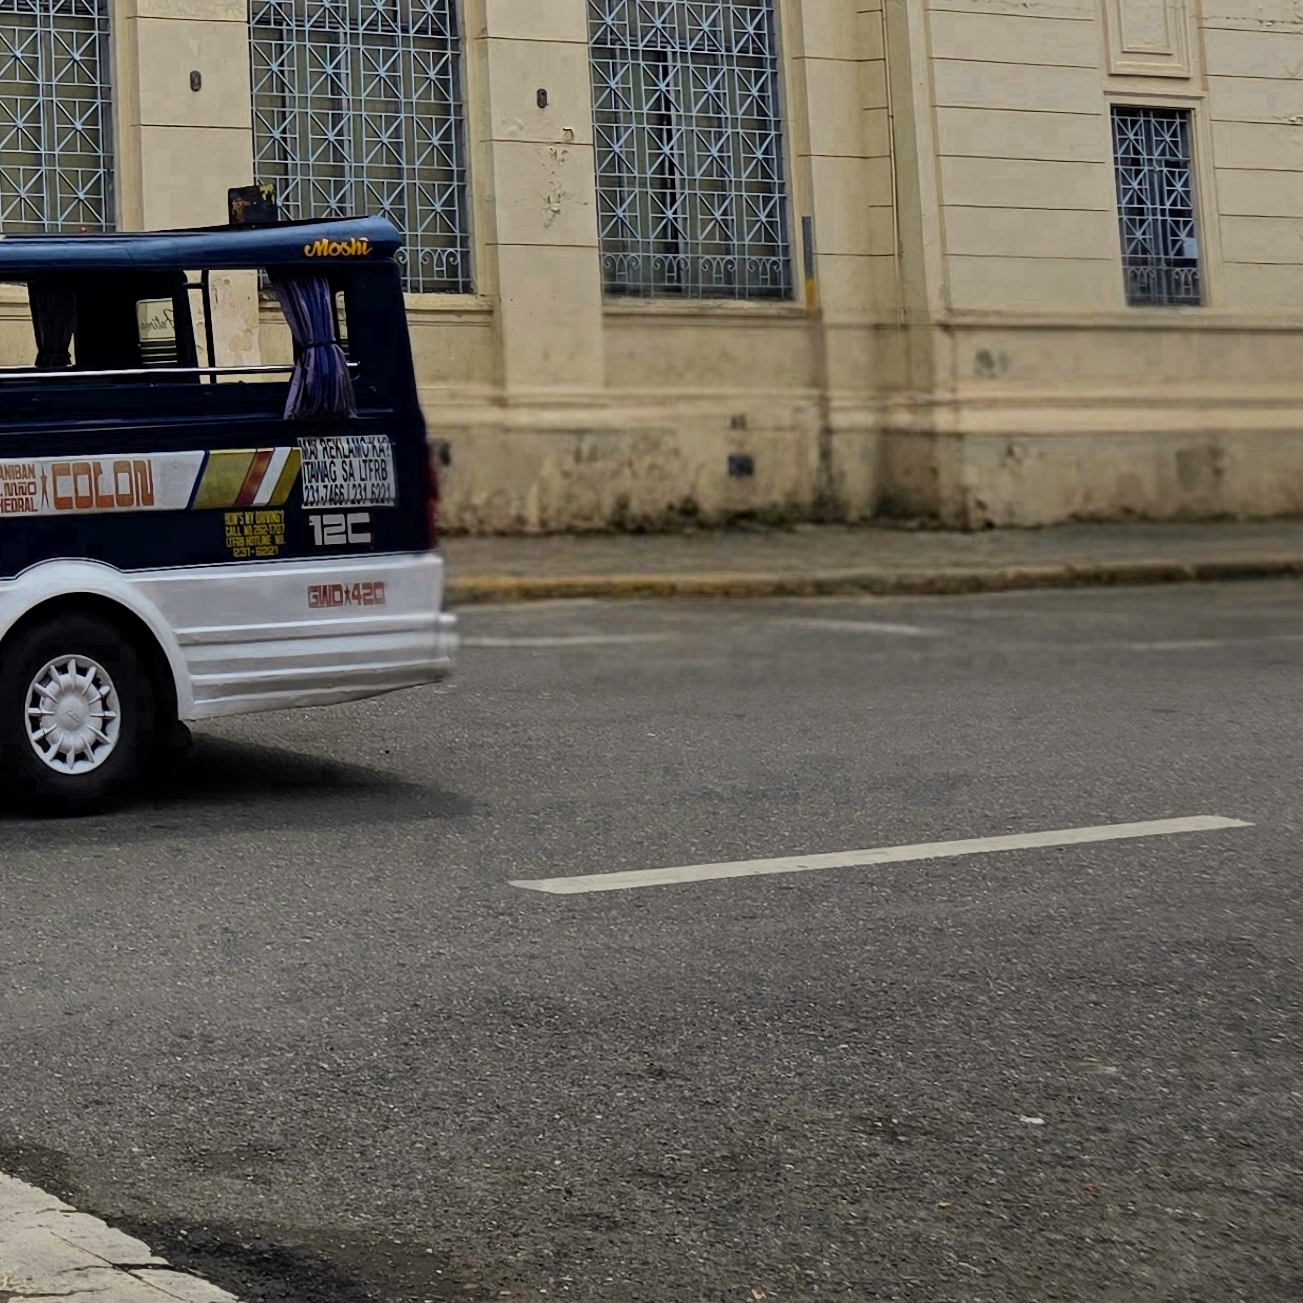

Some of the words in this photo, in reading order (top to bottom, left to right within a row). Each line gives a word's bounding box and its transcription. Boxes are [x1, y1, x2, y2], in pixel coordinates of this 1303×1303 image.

[304, 236, 373, 258] Moshi
[320, 437, 369, 459] REKLAMO
[303, 460, 337, 484] ITAWAG
[341, 459, 355, 482] SA
[359, 458, 387, 482] LTFRB
[51, 459, 155, 510] COLON
[225, 526, 242, 537] CALL
[309, 512, 371, 545] 12C
[307, 584, 344, 608] GWD
[352, 582, 386, 605] 420
